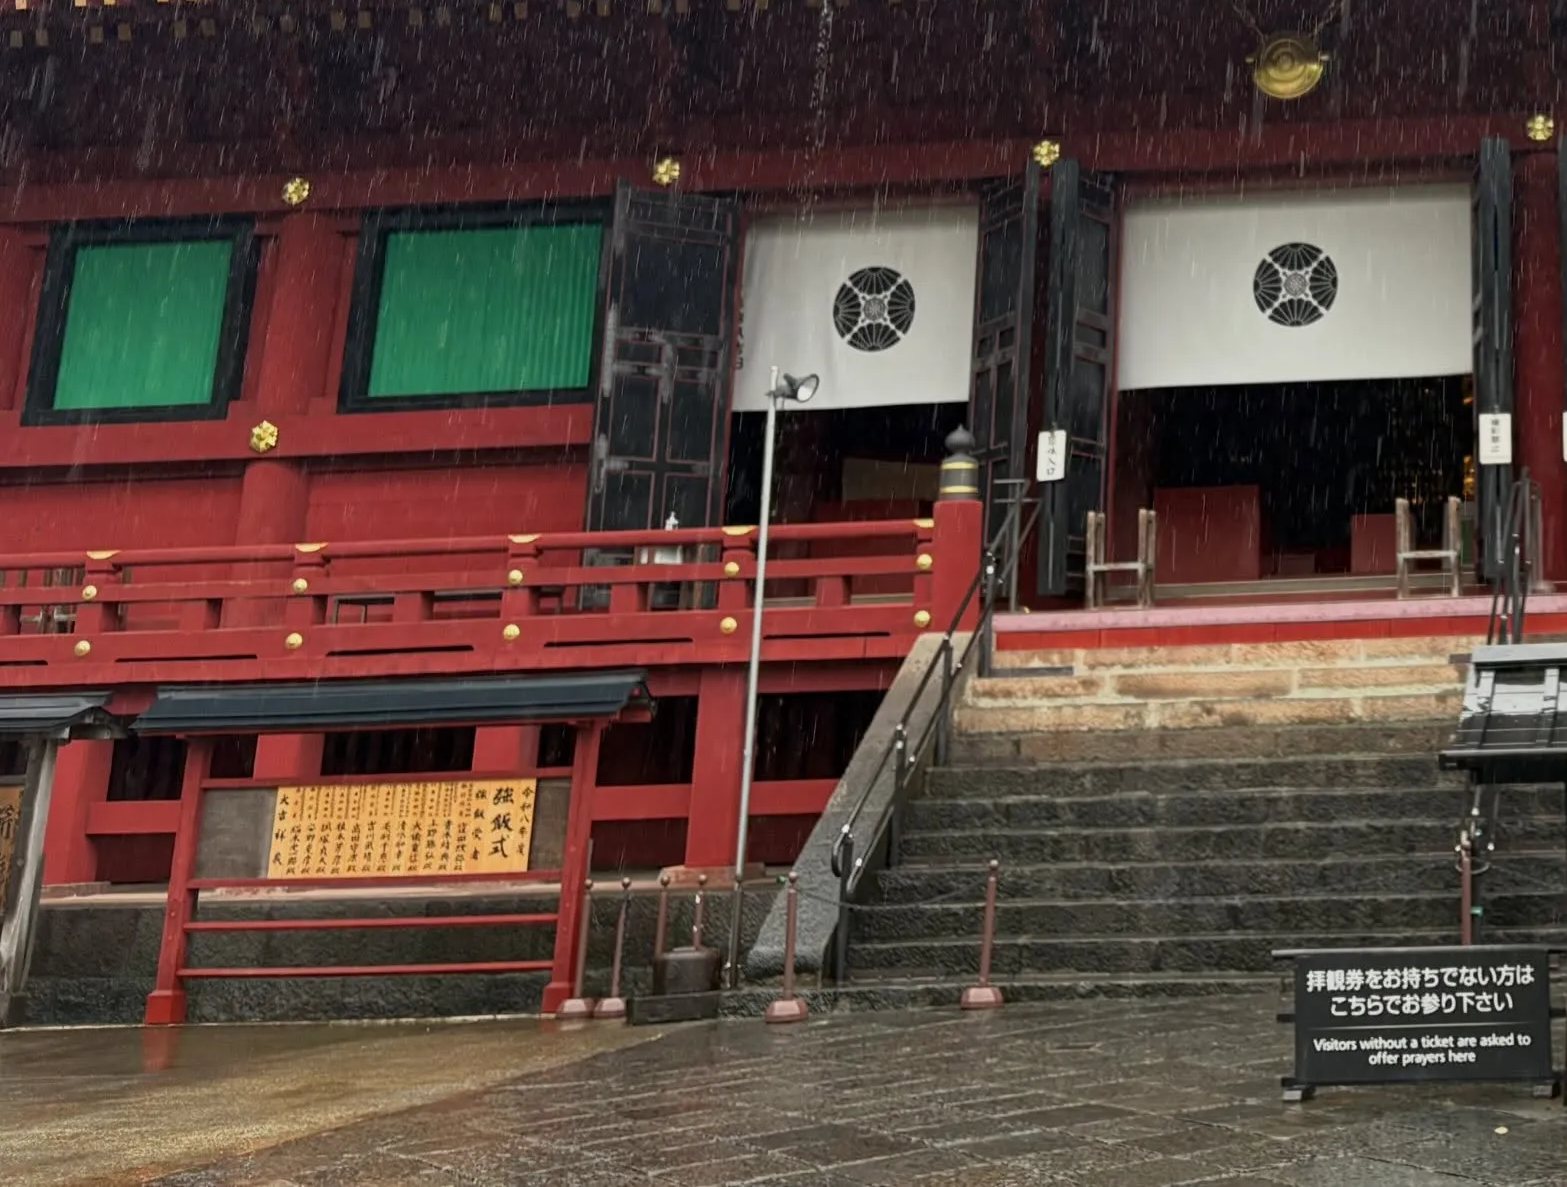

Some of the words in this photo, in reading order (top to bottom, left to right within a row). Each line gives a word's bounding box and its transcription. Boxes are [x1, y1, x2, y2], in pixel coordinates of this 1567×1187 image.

[488, 787, 515, 859] 強飯式
[516, 786, 534, 857] 令和八年度
[1306, 964, 1535, 993] 拝観券をお持ちでない方は
[1330, 991, 1514, 1017] こちらでお参り下さい
[1313, 1038, 1358, 1052] Visitors
[1360, 1036, 1408, 1050] without
[1410, 1040, 1419, 1050] a
[1421, 1035, 1455, 1049] ticket
[1456, 1037, 1478, 1048] are
[1479, 1032, 1515, 1046] asked
[1517, 1033, 1532, 1046] to
[1368, 1051, 1400, 1066] offer
[1402, 1051, 1446, 1067] prayers
[1448, 1050, 1477, 1063] here
